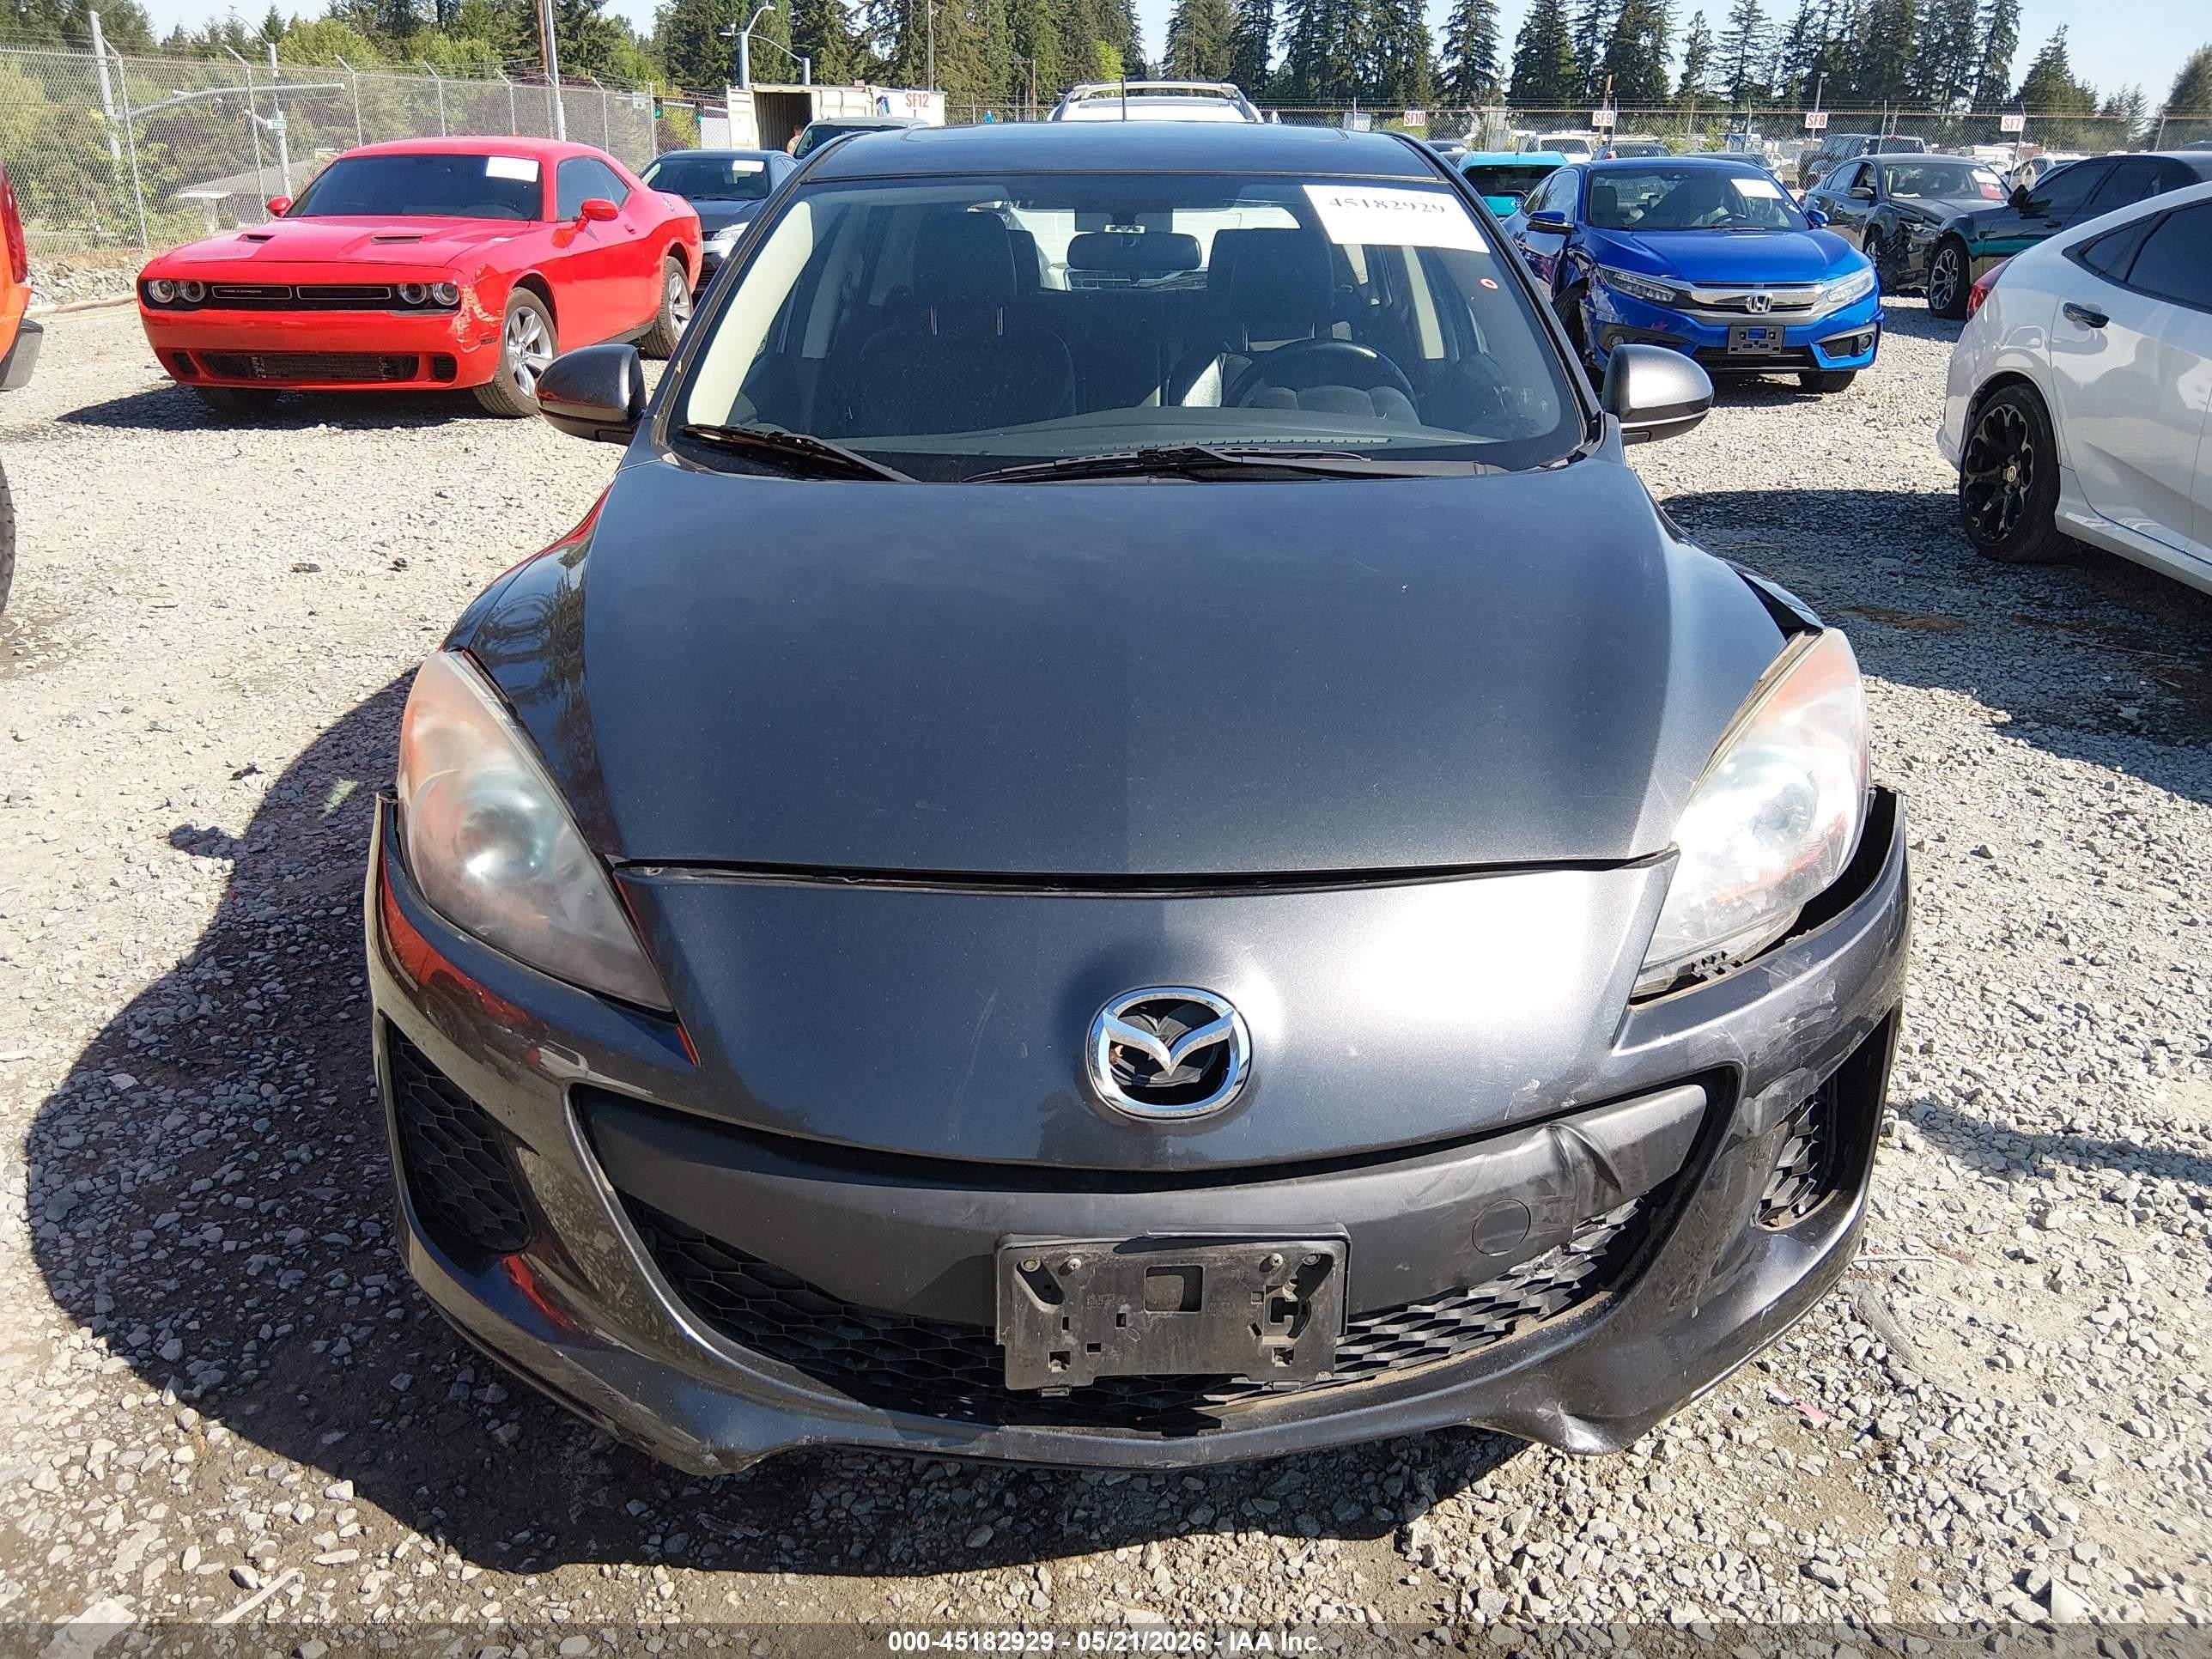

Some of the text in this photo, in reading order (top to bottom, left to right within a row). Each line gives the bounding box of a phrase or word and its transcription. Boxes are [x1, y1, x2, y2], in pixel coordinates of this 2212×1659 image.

[906, 93, 929, 108] SF12
[1405, 112, 1425, 125] SF10
[1595, 112, 1613, 125] SF9
[1808, 114, 1826, 126] SF8
[2003, 118, 2021, 130] SF7
[1329, 198, 1445, 213] 45182929
